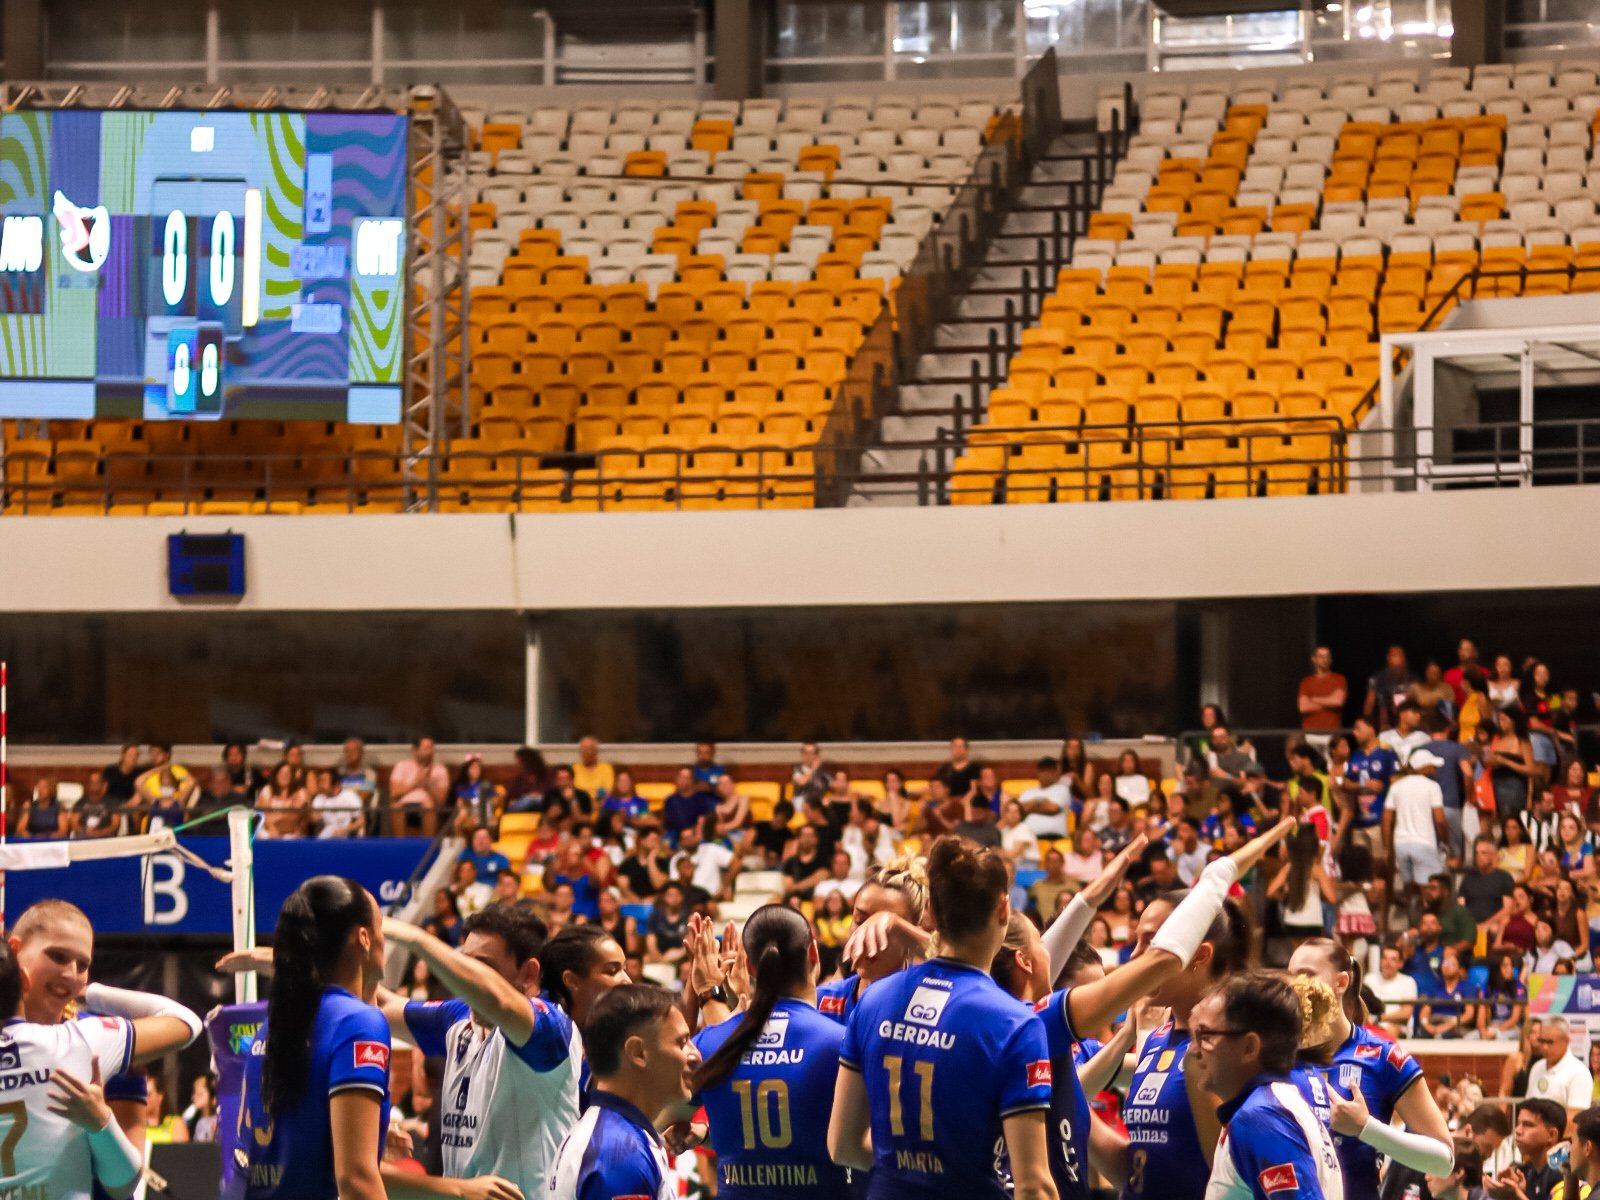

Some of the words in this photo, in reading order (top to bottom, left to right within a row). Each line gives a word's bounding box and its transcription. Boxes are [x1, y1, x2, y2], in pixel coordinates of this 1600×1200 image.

[163, 209, 187, 306] 0
[210, 210, 235, 306] 0
[141, 854, 188, 925] B
[879, 1020, 956, 1050] GERDAU
[740, 1049, 804, 1065] ERDAU
[0, 1068, 49, 1091] DAU
[883, 1056, 935, 1141] 11
[731, 1079, 793, 1150] 10
[724, 1163, 818, 1186] VALLENTINA
[896, 1151, 944, 1175] MARIA
